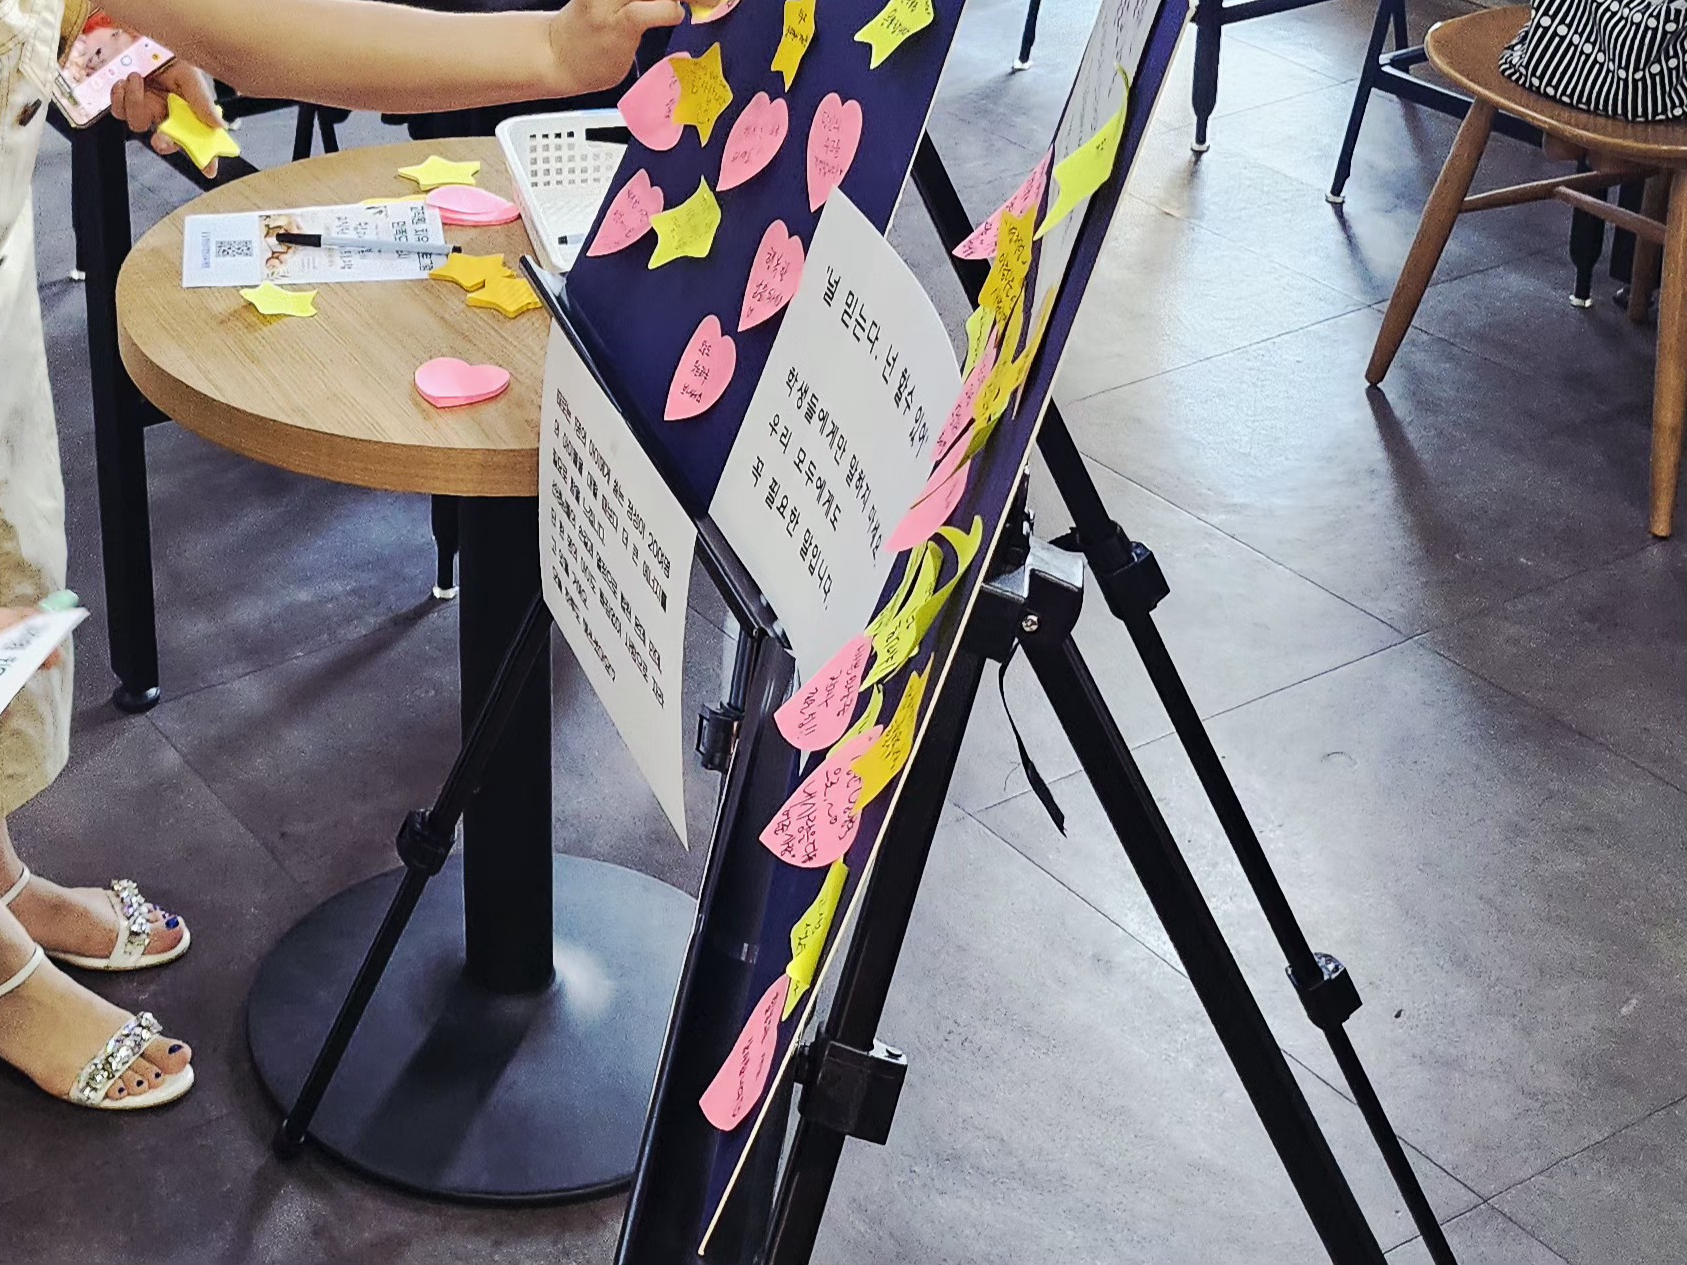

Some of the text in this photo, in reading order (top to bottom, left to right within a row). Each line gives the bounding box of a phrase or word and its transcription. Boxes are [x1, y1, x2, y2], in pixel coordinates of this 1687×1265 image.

[840, 289, 879, 362] 믿는다.
[882, 343, 900, 386] 넌
[894, 367, 917, 417] 할수
[767, 413, 842, 532] 우리 모두에게도
[785, 366, 848, 467] 학생들에게만
[845, 453, 872, 514] 말하지
[621, 526, 630, 552] 더
[631, 542, 640, 568] 큰
[626, 498, 647, 541] 정성이
[749, 456, 765, 492] 꼭
[764, 476, 802, 538] 필요한
[799, 527, 833, 611] 말입니다.
